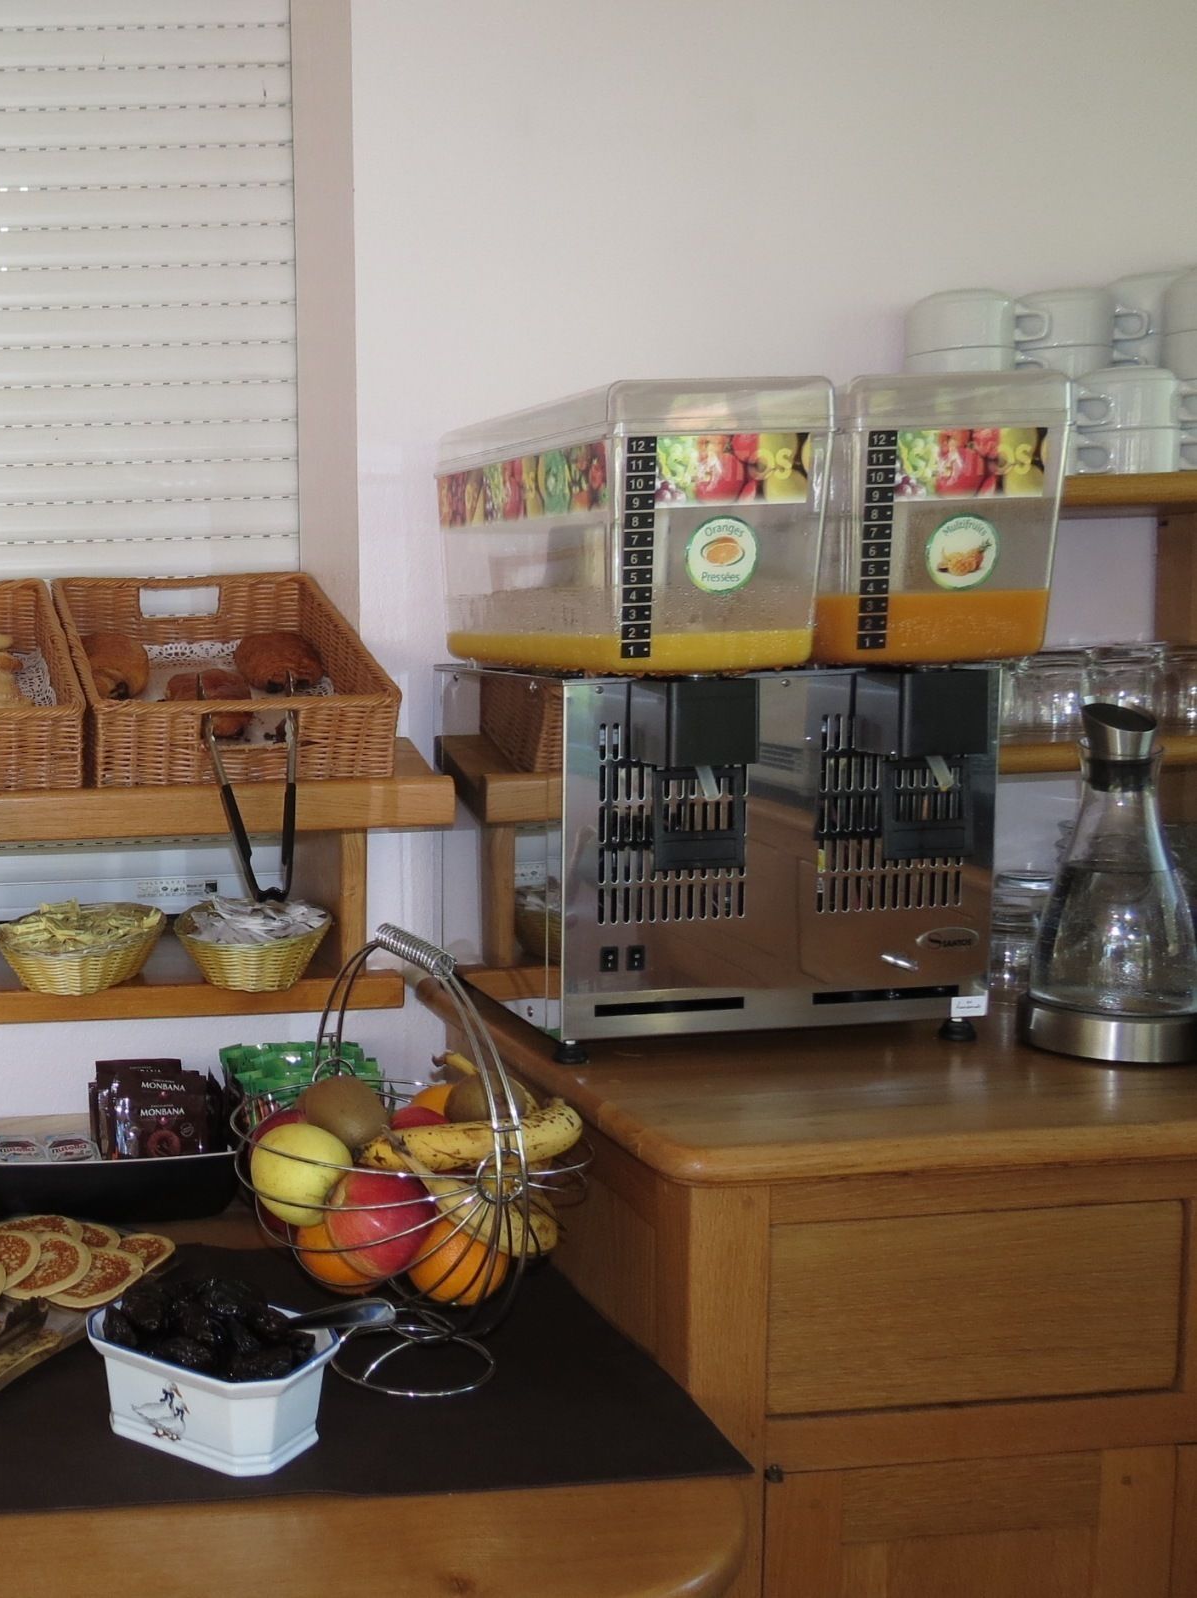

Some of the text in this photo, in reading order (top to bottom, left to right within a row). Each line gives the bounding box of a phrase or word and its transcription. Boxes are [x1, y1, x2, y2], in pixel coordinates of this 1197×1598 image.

[872, 434, 886, 445] 12
[631, 440, 645, 451] 12
[871, 453, 884, 464] 11
[630, 459, 642, 471] 11
[870, 471, 884, 483] 10
[629, 478, 644, 490] 10
[872, 490, 880, 501] 9
[632, 497, 640, 508] 9
[870, 508, 879, 520] 8
[631, 516, 639, 527] 8
[704, 524, 745, 538] Oranges
[869, 527, 878, 538] 7
[630, 535, 639, 545] 7
[868, 546, 876, 557] 6
[630, 553, 638, 564] 6
[867, 564, 875, 575] 5
[630, 572, 637, 583] 5
[866, 582, 875, 593] 4
[629, 590, 637, 601] 4
[866, 600, 874, 612] 3
[628, 609, 636, 620] 3
[865, 618, 873, 629] 2
[628, 627, 636, 638] 2
[864, 638, 870, 648] 1
[628, 645, 634, 656] 1
[141, 1081, 186, 1091] MONBANA
[140, 1107, 185, 1117] MONBANA
